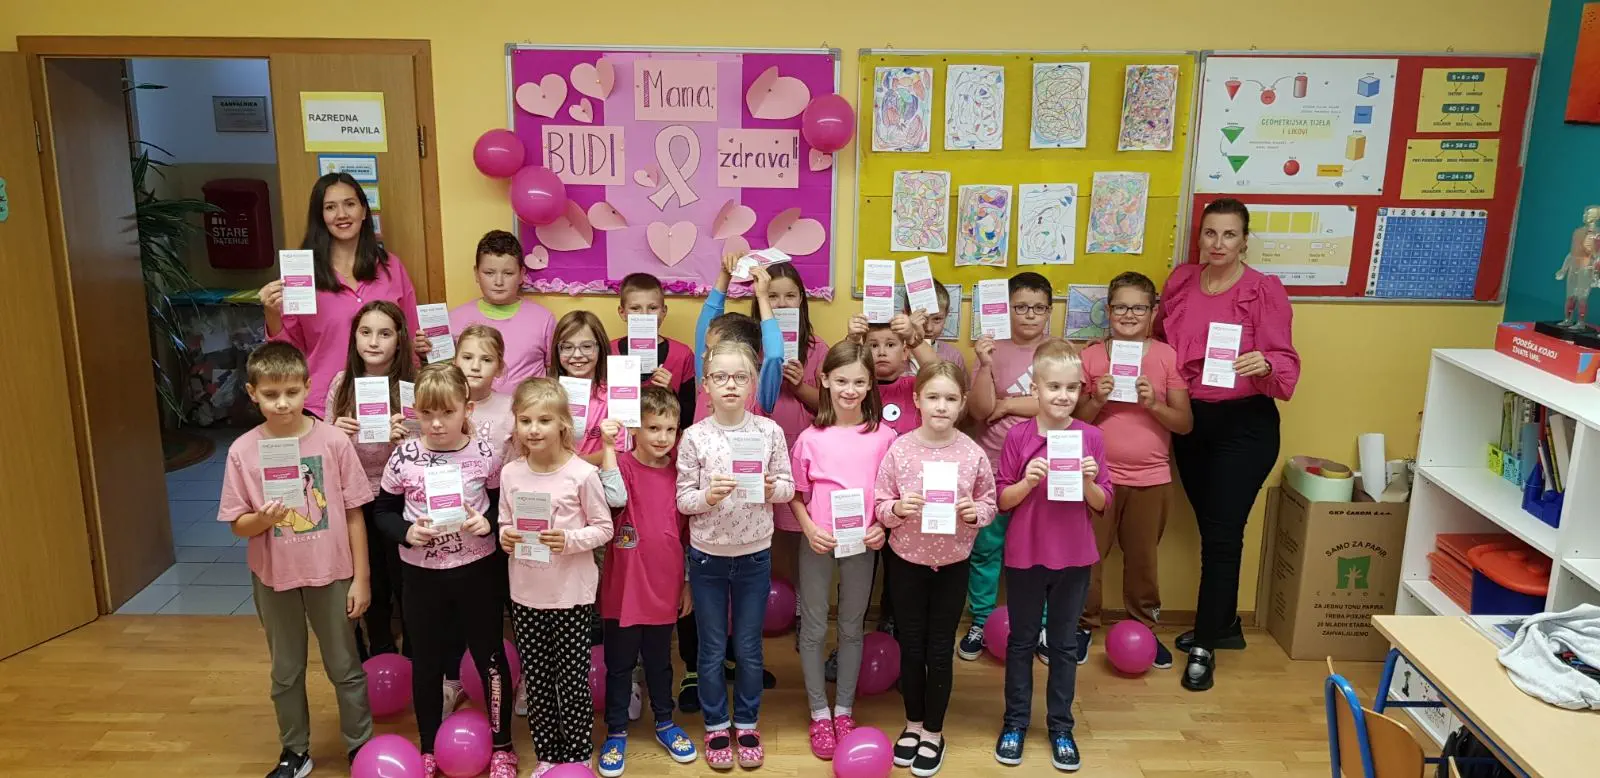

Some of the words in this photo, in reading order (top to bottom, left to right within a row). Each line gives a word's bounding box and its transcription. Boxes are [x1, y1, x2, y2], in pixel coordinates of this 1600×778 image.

[643, 69, 714, 109] Mama,
[308, 113, 358, 122] RAZREDNA
[1310, 118, 1331, 127] TIJELA
[341, 126, 380, 134] PRAVILA
[1287, 128, 1308, 136] LIKOVI
[547, 131, 615, 177] BUDI
[719, 136, 798, 169] zdrava!
[212, 227, 248, 237] STARE
[1512, 336, 1538, 351] PODRŠKA
[1538, 347, 1558, 359] KOJOJ
[1325, 542, 1349, 557] SAMO
[1364, 541, 1387, 558] PAPIR
